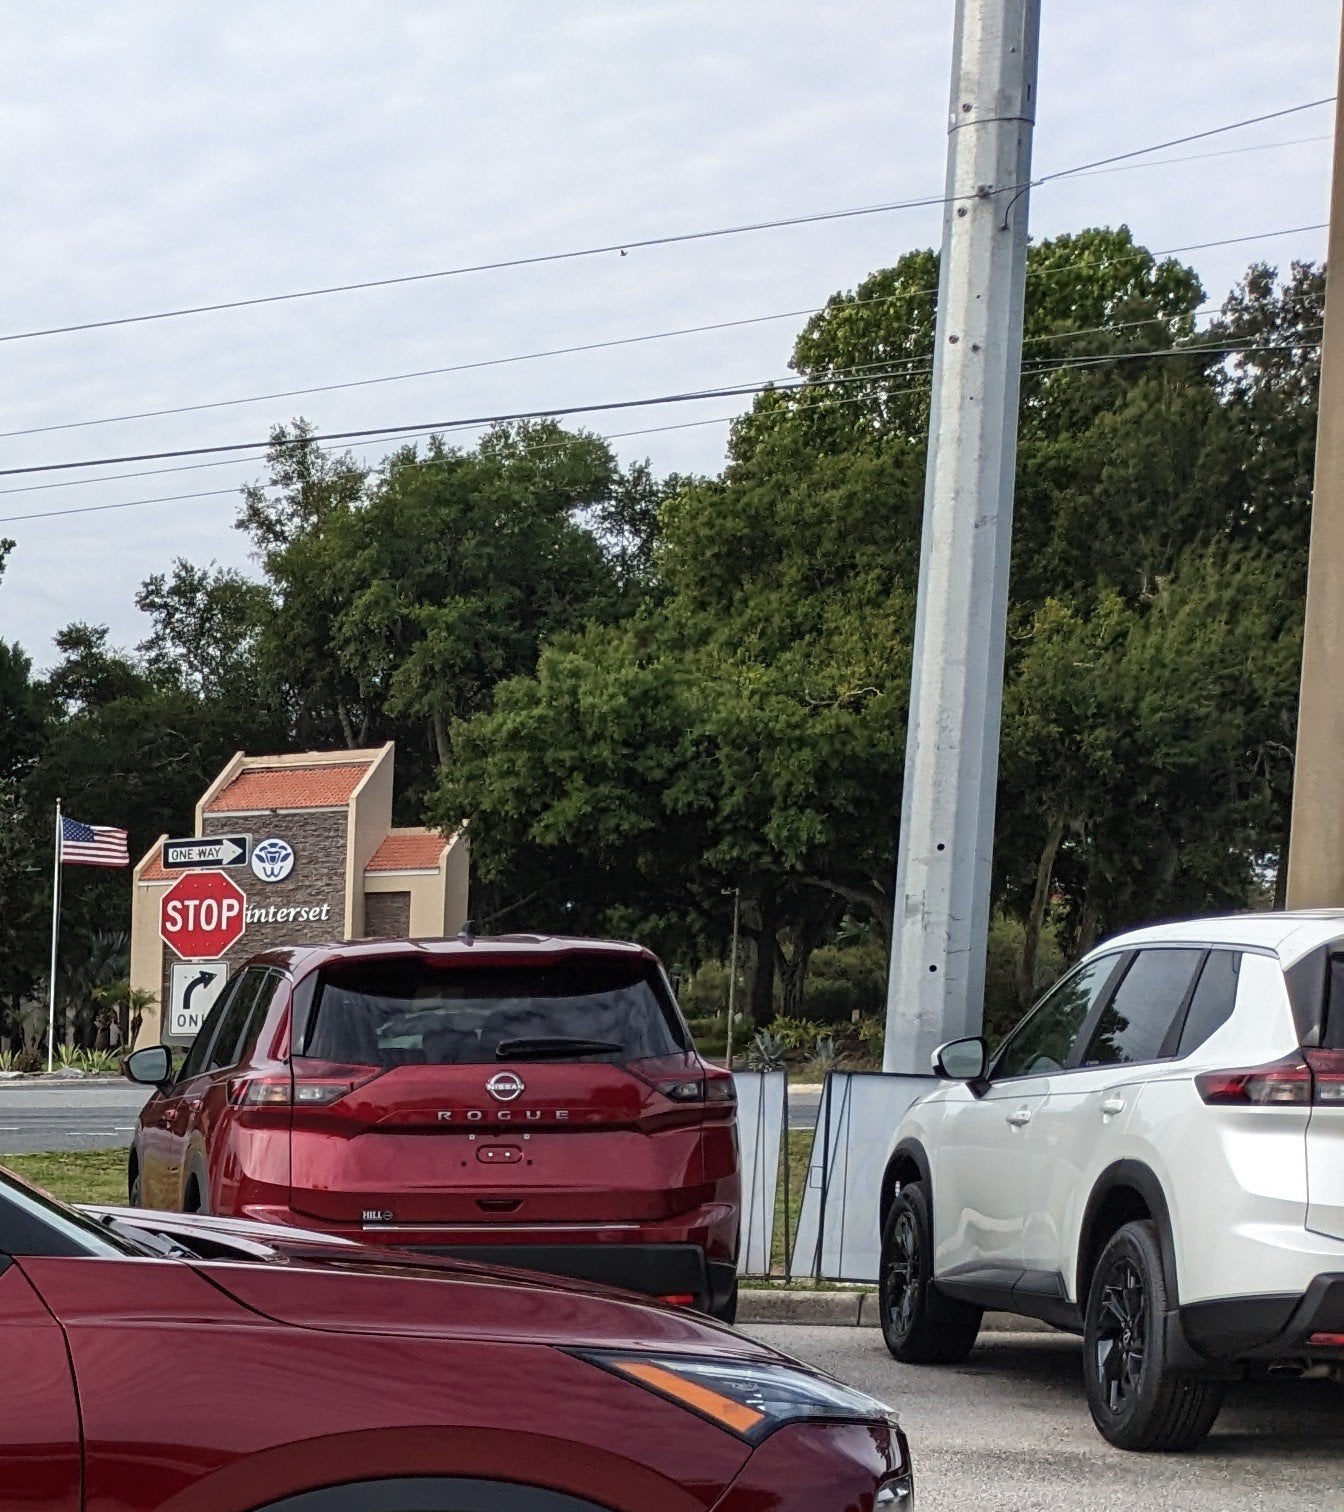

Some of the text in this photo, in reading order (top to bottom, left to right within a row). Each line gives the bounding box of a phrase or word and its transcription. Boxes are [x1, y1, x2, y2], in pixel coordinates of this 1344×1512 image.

[171, 846, 221, 861] ONE WAY
[165, 898, 240, 932] STOP
[245, 903, 331, 923] interset
[487, 1083, 524, 1091] NISSAN
[437, 1110, 569, 1120] ROGUE
[362, 1210, 382, 1219] HILL
